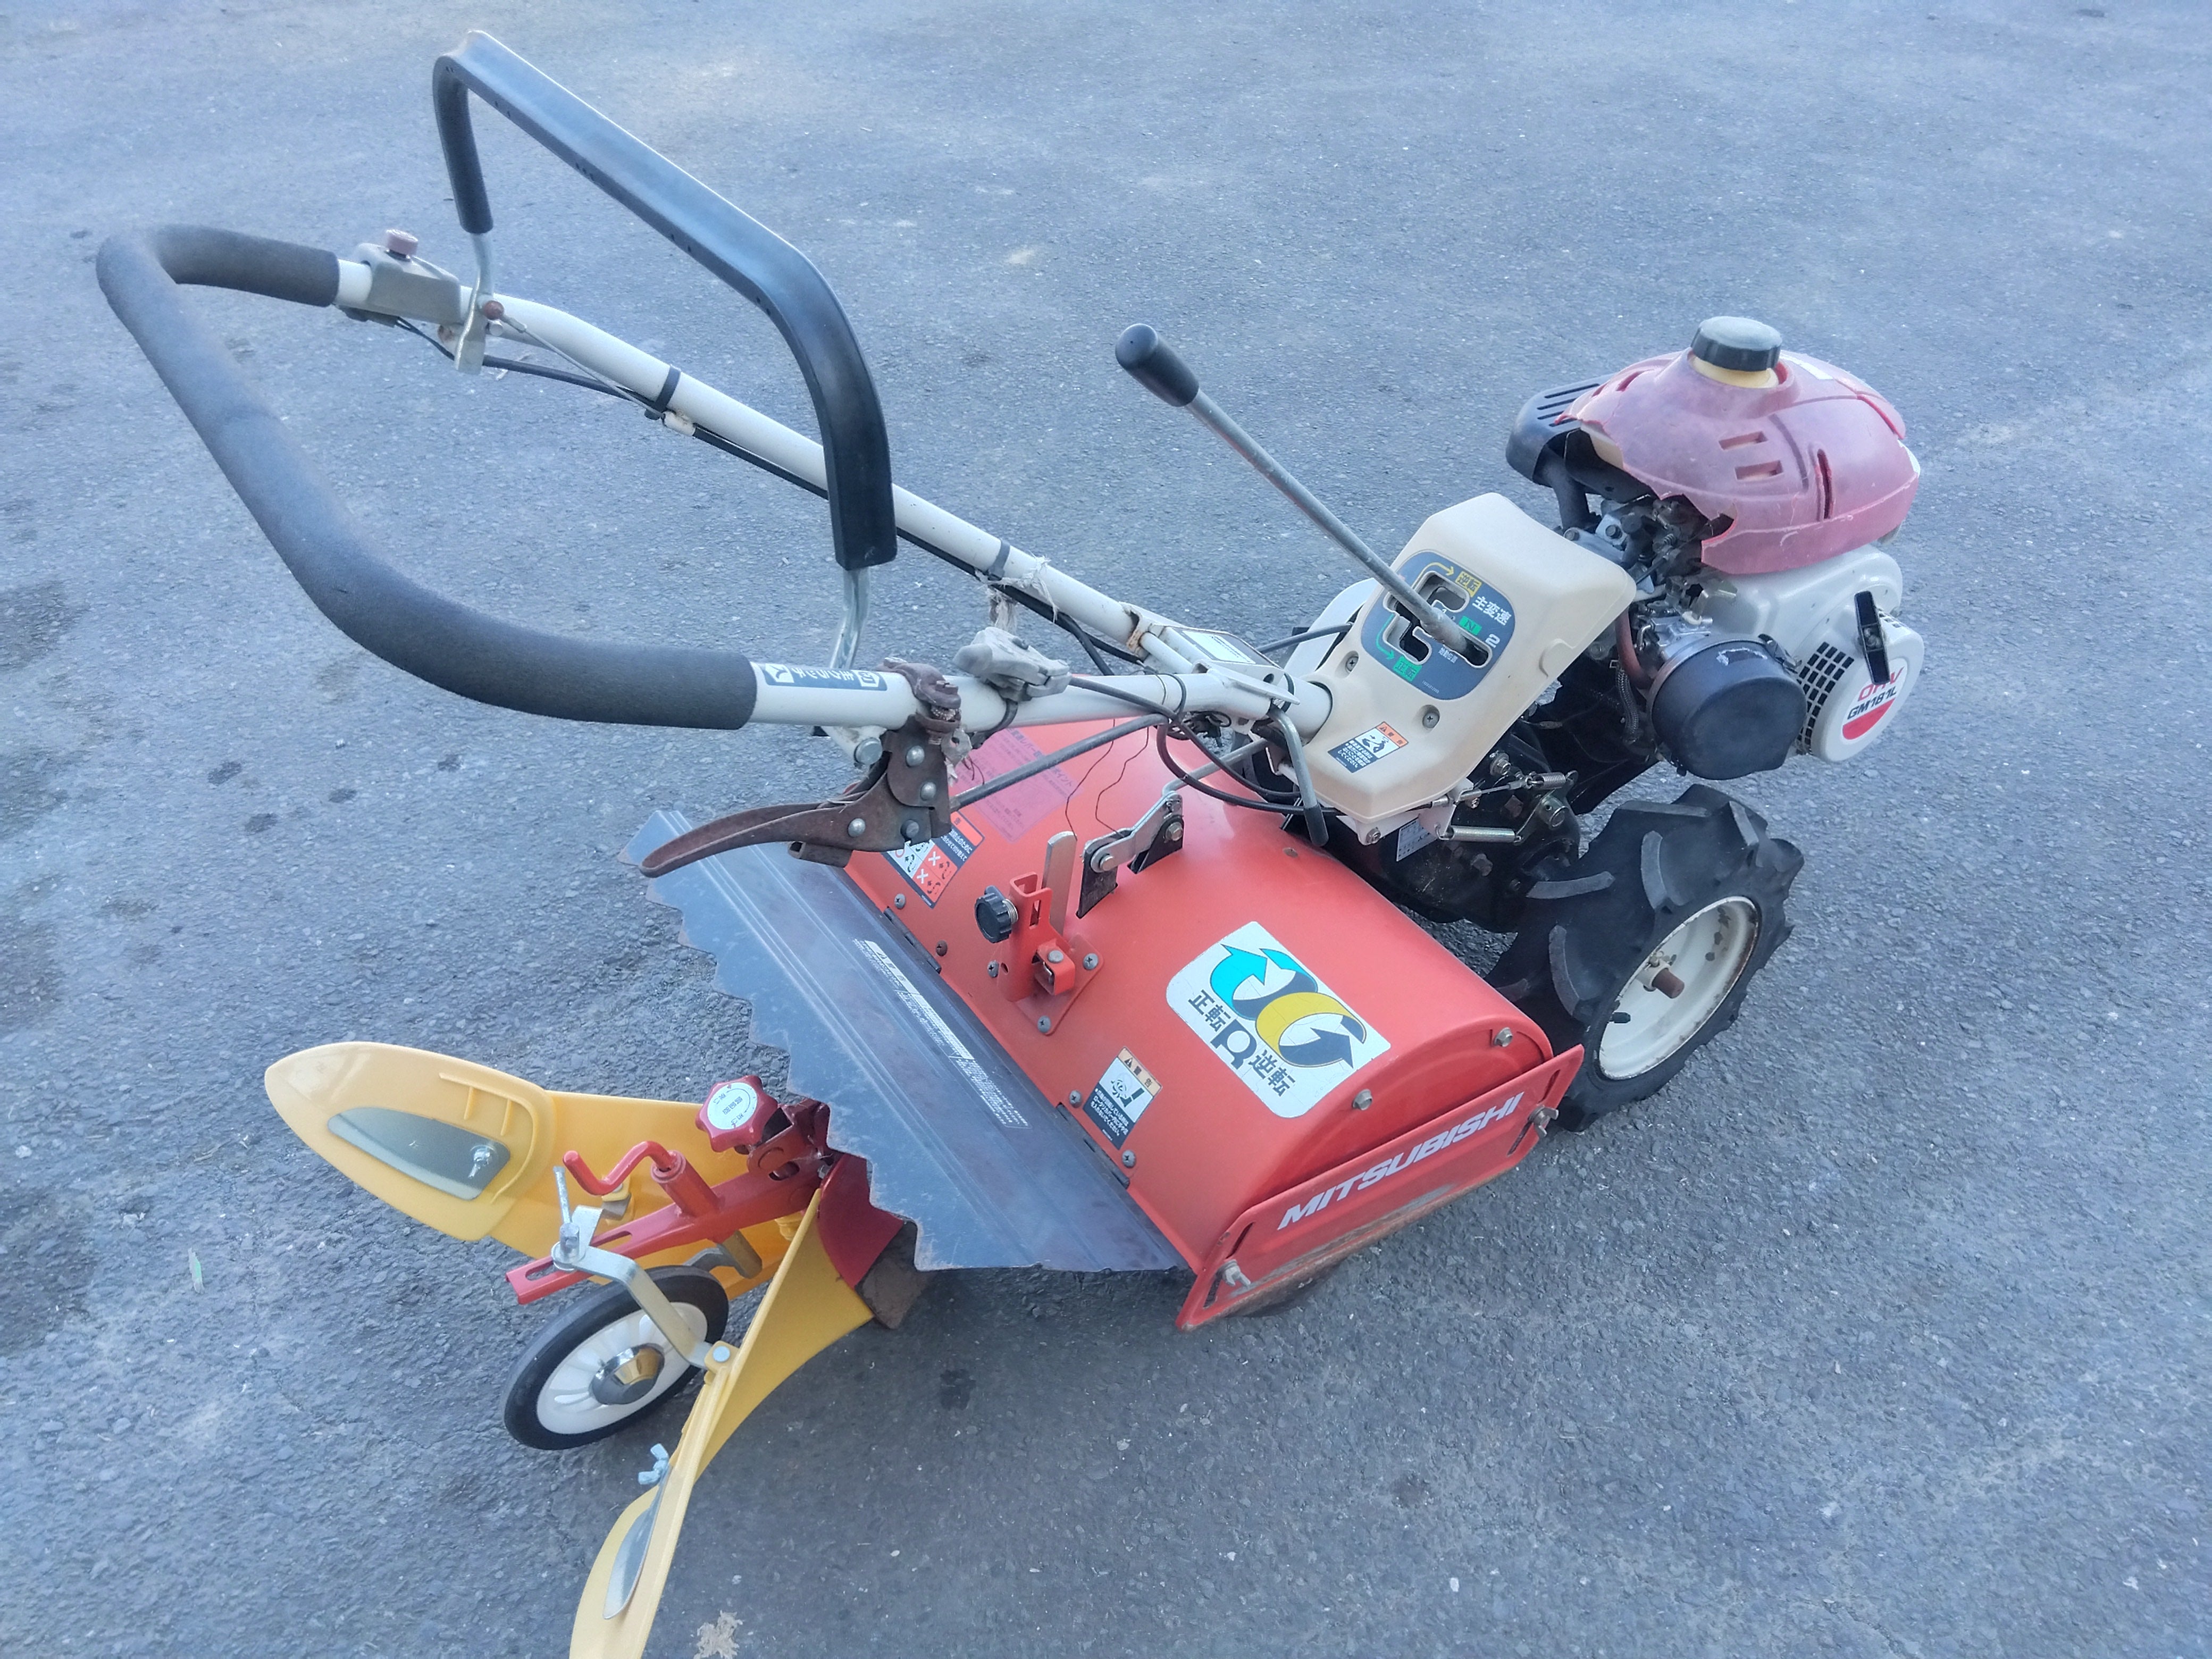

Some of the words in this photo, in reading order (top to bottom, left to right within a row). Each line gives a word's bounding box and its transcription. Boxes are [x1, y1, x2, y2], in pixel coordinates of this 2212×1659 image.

[1457, 573, 1479, 592] 逆転
[1472, 596, 1512, 626] 主変速
[1464, 621, 1476, 632] N
[1485, 633, 1501, 649] 2
[1847, 686, 1897, 719] GM181L
[1188, 989, 1231, 1032] 正転
[1248, 1049, 1296, 1097] 逆転
[1277, 1092, 1524, 1230] MITSUBISHI
